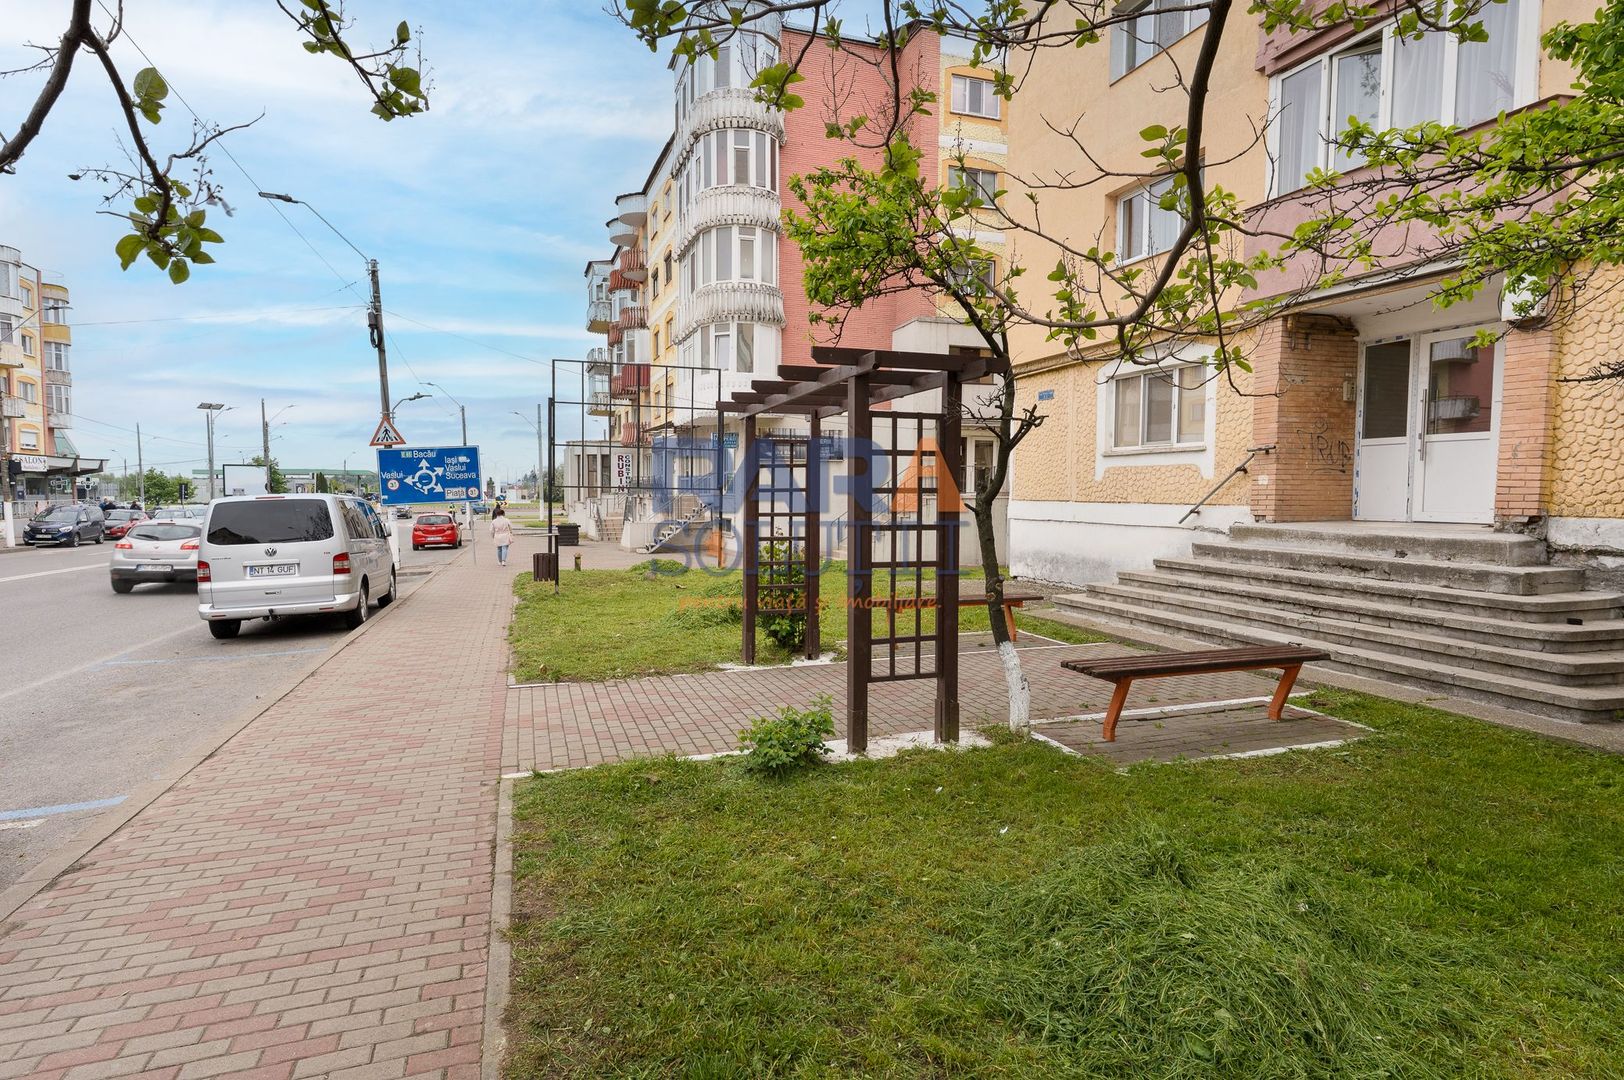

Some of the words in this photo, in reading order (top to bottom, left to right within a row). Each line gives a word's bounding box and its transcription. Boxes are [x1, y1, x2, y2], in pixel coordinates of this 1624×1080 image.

[413, 449, 436, 458] Bacău
[445, 463, 466, 471] Vaslui
[381, 470, 403, 479] Vaslui
[445, 472, 476, 480] Suceava
[277, 565, 293, 573] GUF
